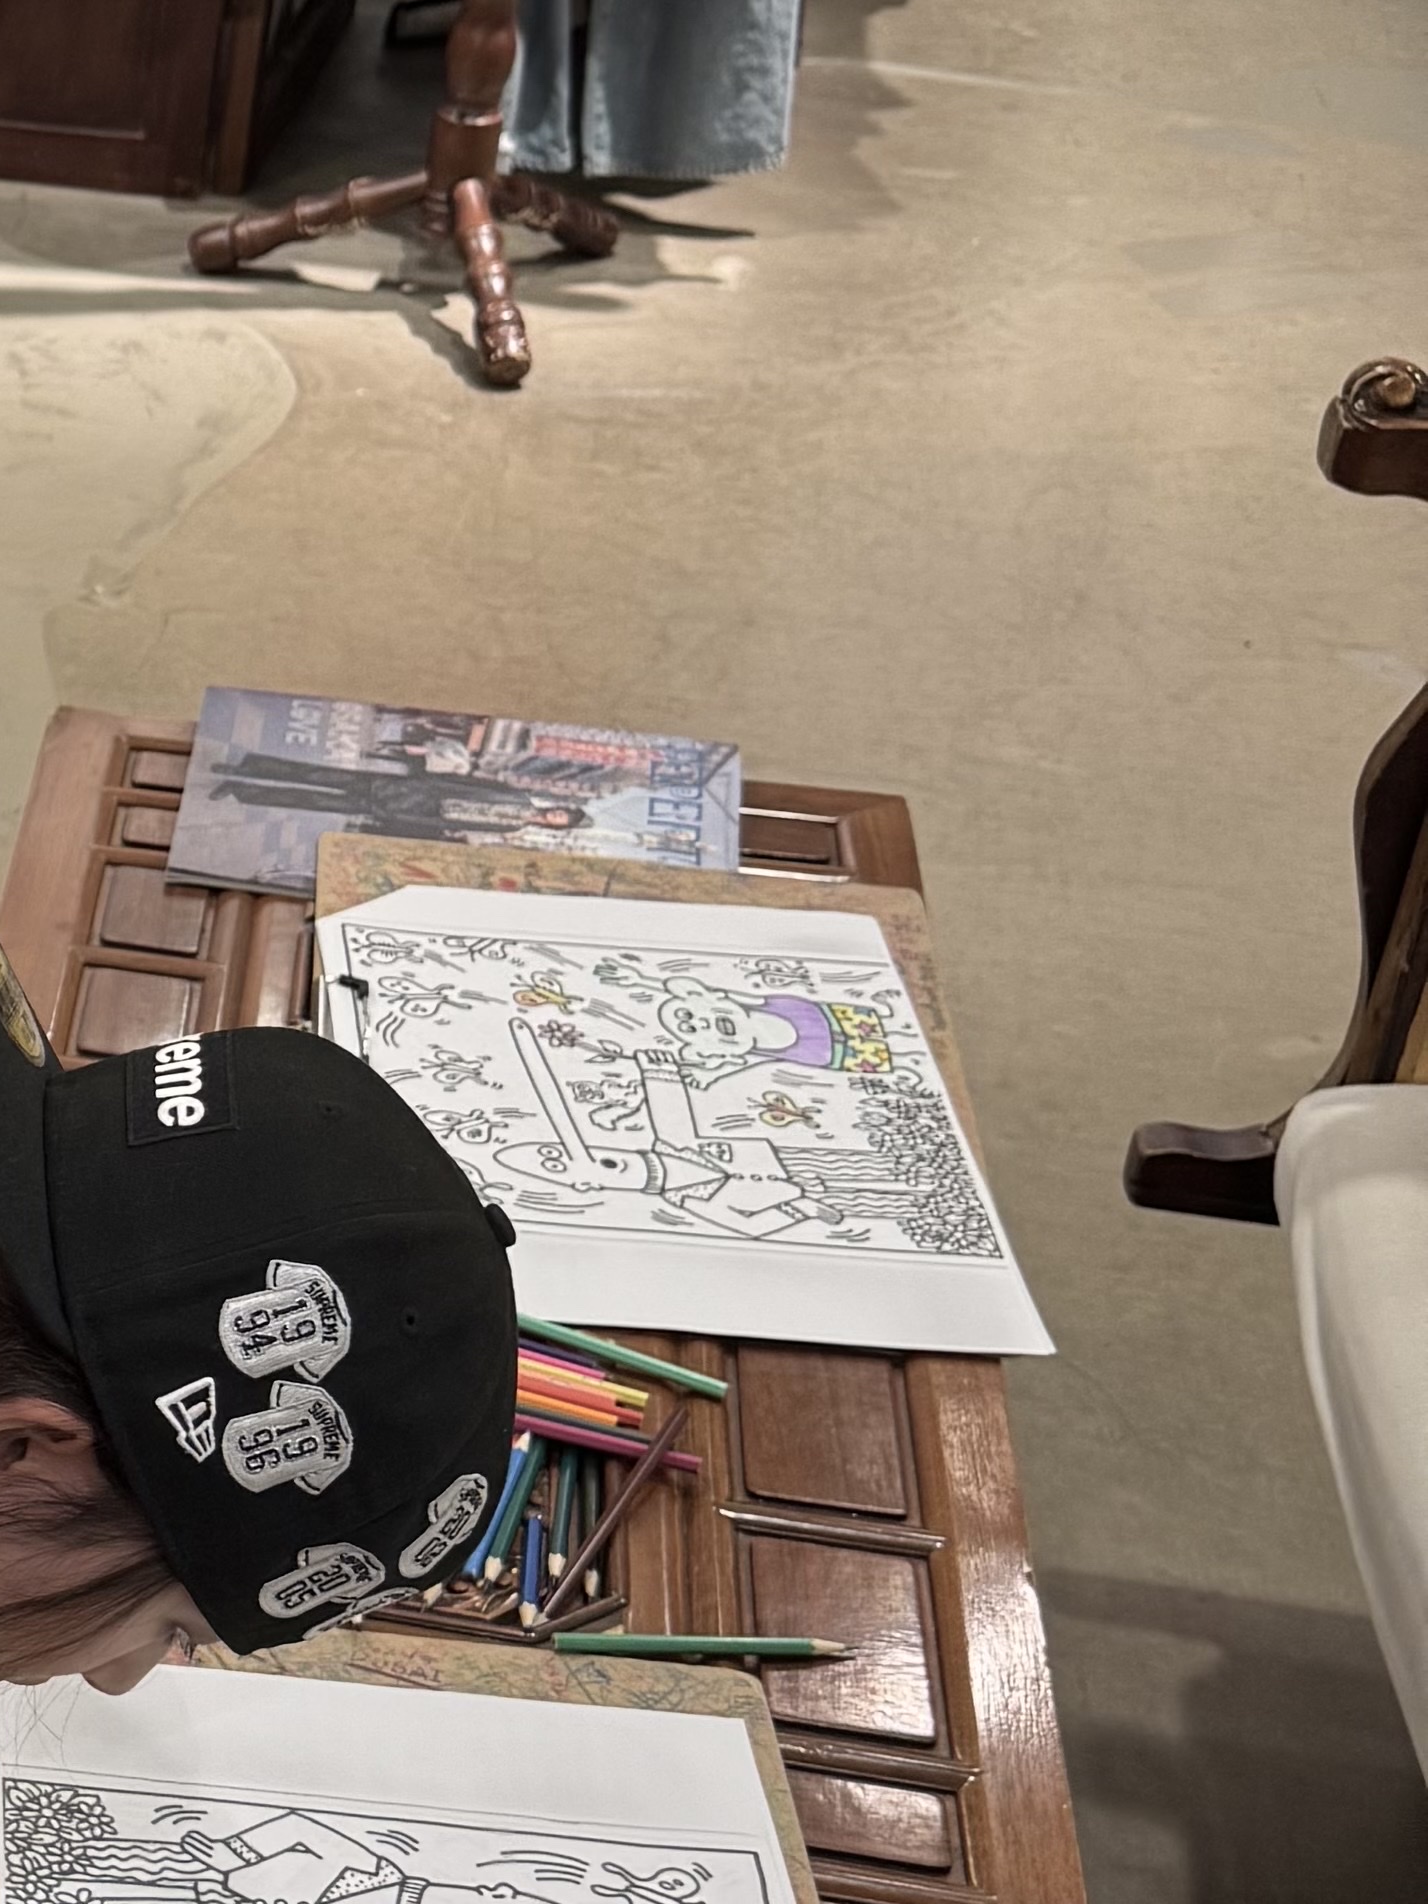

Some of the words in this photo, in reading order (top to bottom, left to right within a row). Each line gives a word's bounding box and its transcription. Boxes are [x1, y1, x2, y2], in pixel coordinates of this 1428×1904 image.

[234, 1309, 278, 1360] 94
[272, 1298, 316, 1343] 19
[304, 1281, 339, 1345] SUPREME
[238, 1427, 281, 1473] 96
[275, 1418, 318, 1460] 19
[308, 1400, 341, 1462] SUPREME
[274, 1580, 317, 1609] 05
[308, 1564, 351, 1593] 20
